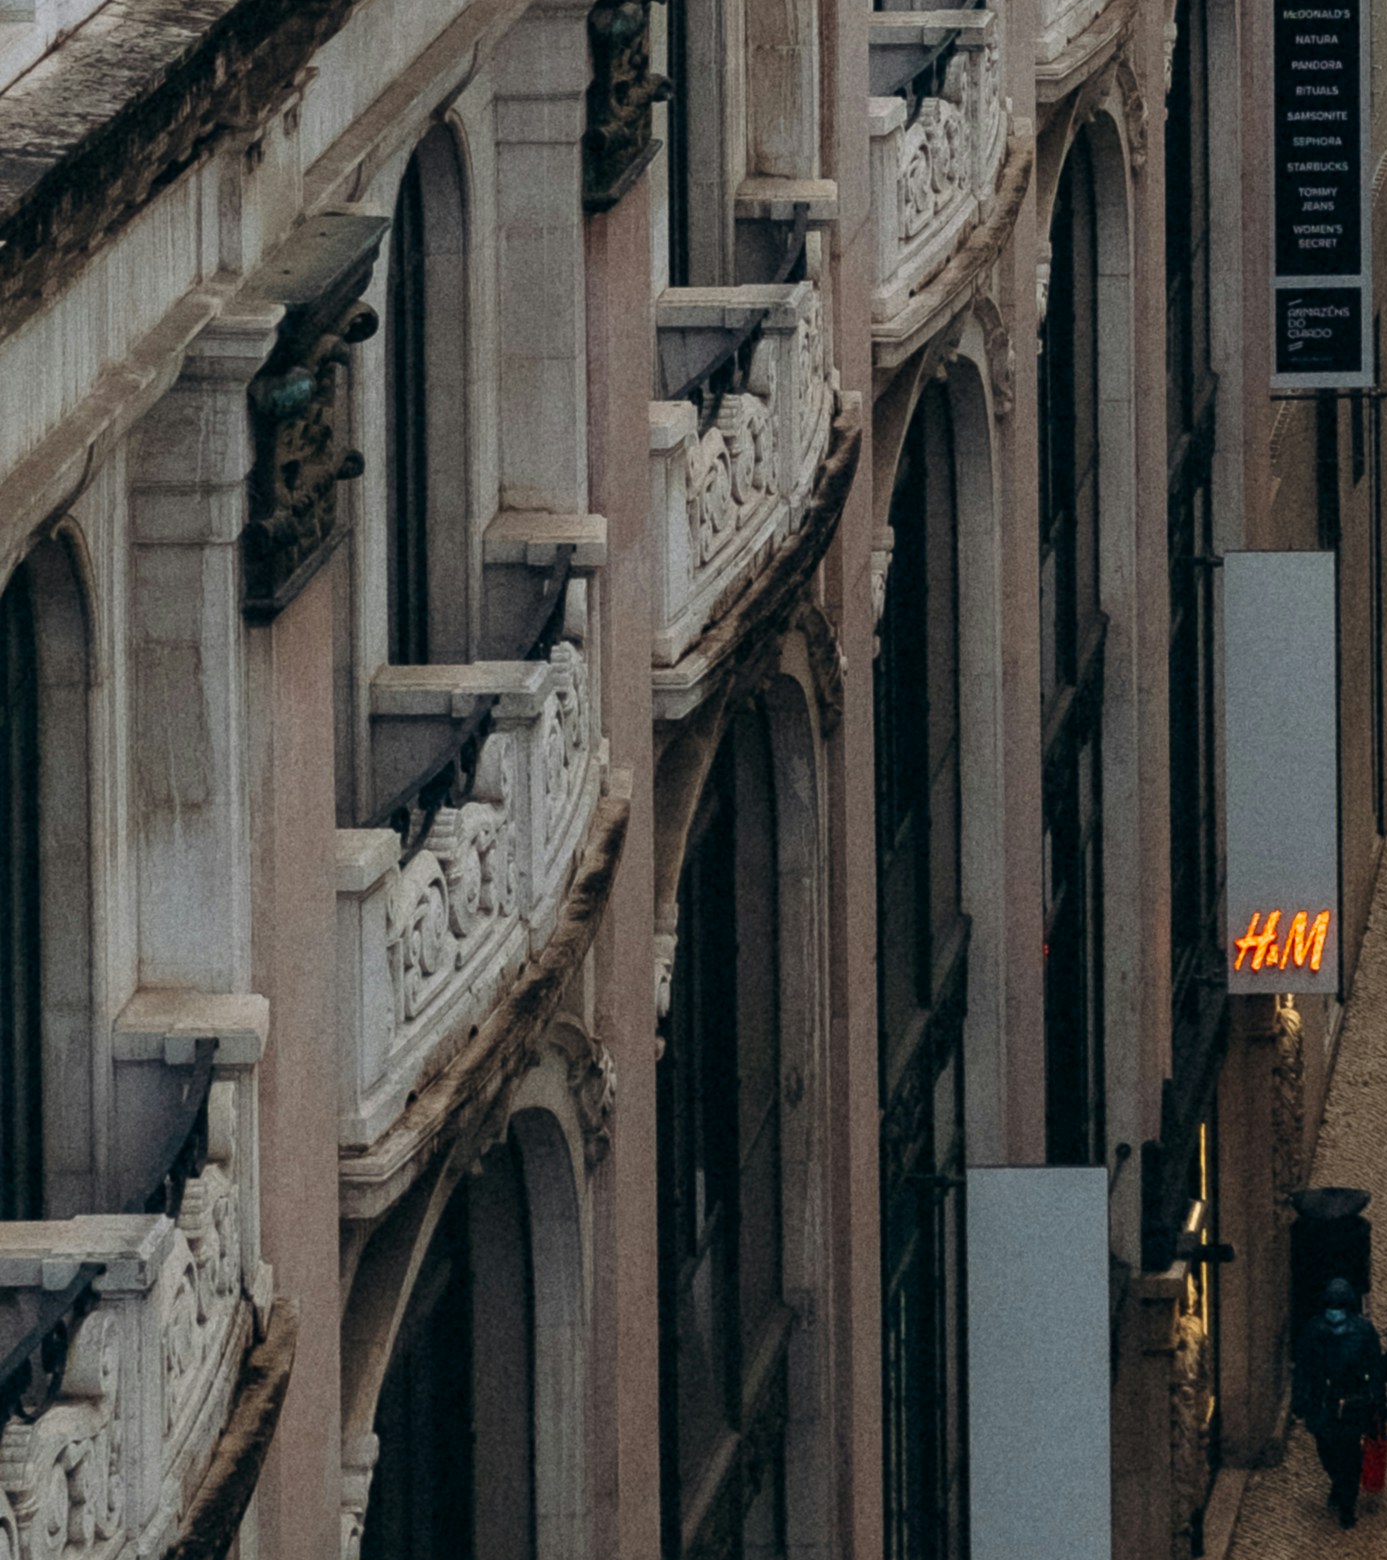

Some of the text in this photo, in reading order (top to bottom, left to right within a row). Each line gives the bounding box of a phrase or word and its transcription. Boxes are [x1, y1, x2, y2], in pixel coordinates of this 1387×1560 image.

[1295, 34, 1338, 44] NATURA
[1291, 60, 1343, 70] PANDORA
[1296, 86, 1339, 95] RITUALS
[1287, 111, 1347, 121] SAMSONITE
[1293, 137, 1342, 146] SEPHORA
[1287, 162, 1349, 171] STARBUCKS
[1299, 187, 1337, 197] TOMMY
[1302, 202, 1334, 211] JEANS
[1298, 238, 1337, 248] SECRET
[1287, 318, 1307, 329] DO
[1233, 908, 1331, 973] H&M
